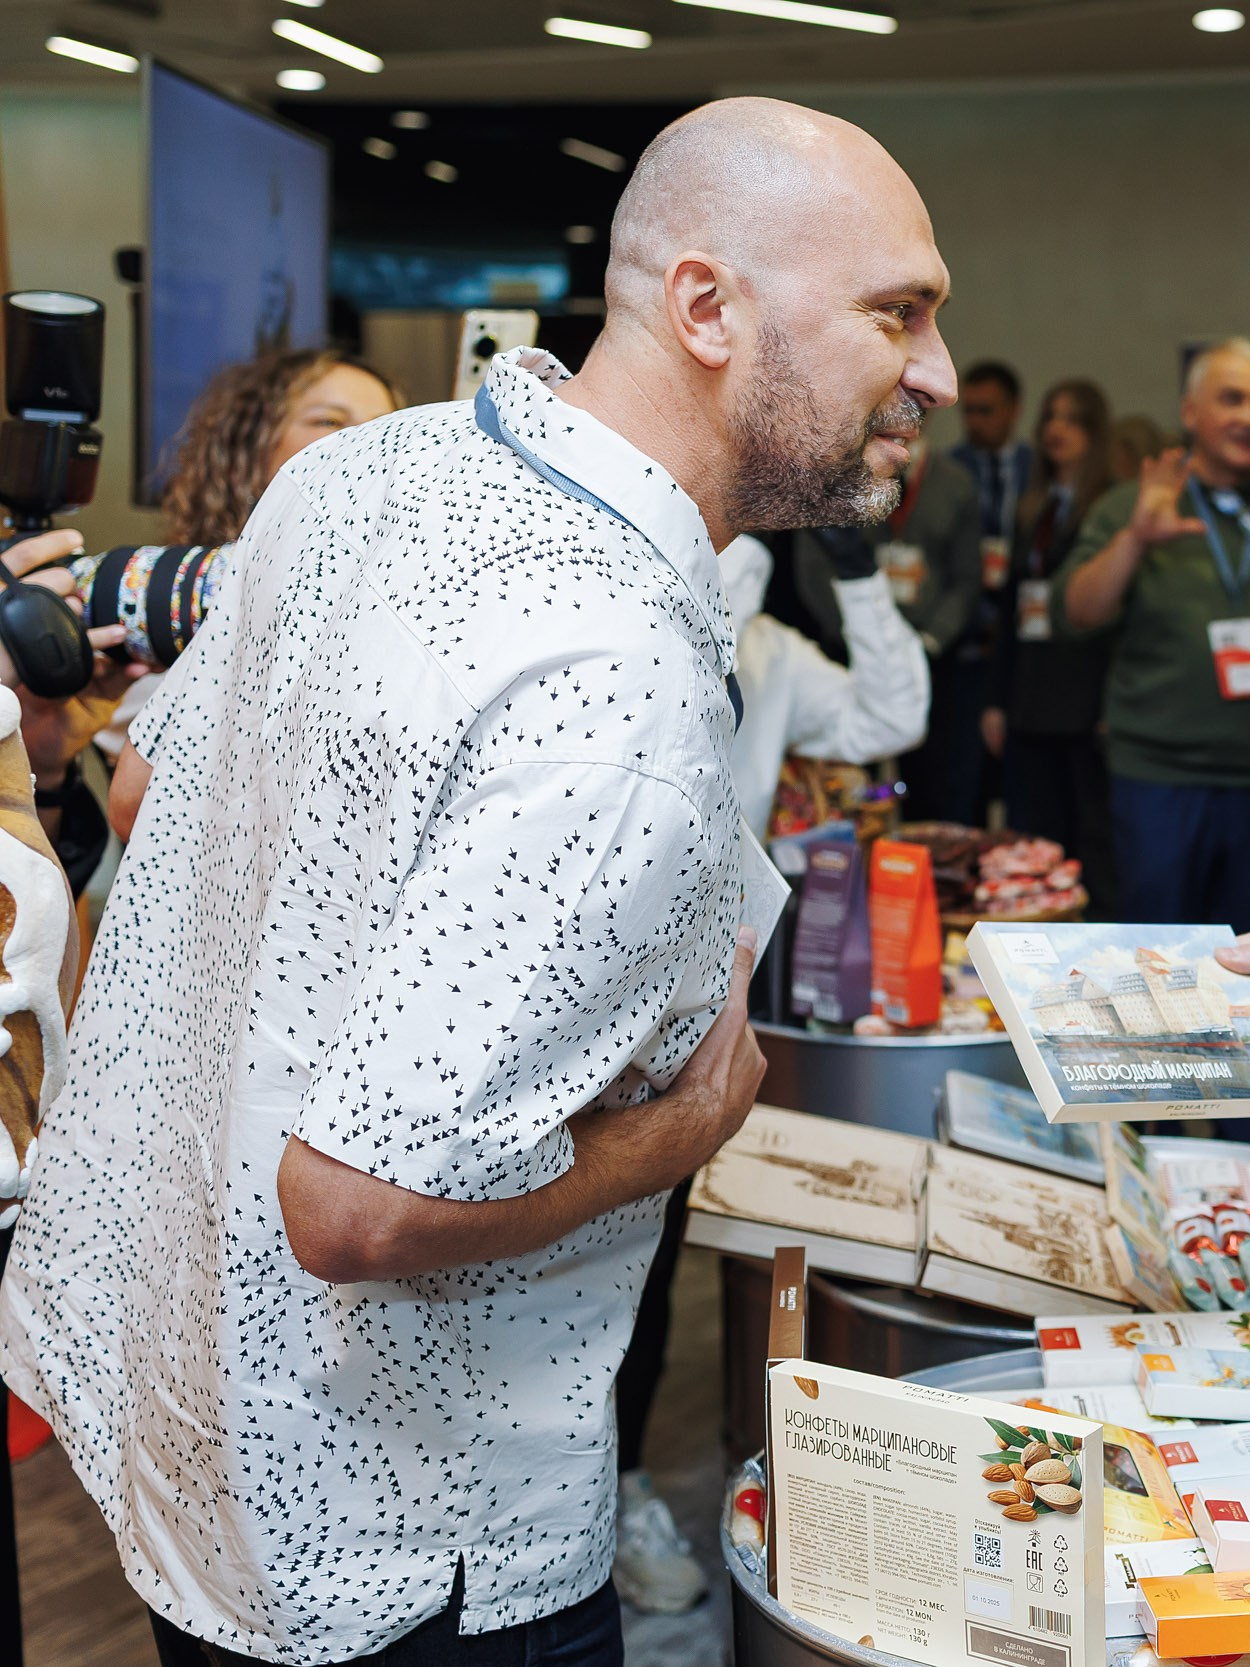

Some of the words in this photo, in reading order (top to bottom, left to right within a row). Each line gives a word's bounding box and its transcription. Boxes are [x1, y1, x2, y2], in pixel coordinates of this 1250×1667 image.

[1061, 1060, 1166, 1082] БЛАГОРОДНЫЙ
[1166, 1062, 1233, 1081] МАРЦИПАН
[1071, 1083, 1102, 1092] конфеты
[1137, 1082, 1172, 1090] шоколаде
[1166, 1103, 1220, 1111] POMATTI
[903, 1386, 969, 1402] POMATTI
[785, 1408, 849, 1439] КОНФЕТЫ
[853, 1424, 957, 1464] МАРЦИПАНОВЫЕ
[785, 1431, 892, 1472] ГЛАЗИРОВАННЫЕ
[929, 1601, 947, 1612] МЕС.
[906, 1609, 914, 1617] 12
[915, 1611, 934, 1622] MON.
[913, 1628, 926, 1637] 130
[909, 1634, 922, 1643] 130
[923, 1639, 928, 1647] g
[1005, 1641, 1034, 1654] СДЕЛАНО
[999, 1648, 1046, 1666] КАЛИНИНГРАДЕ
